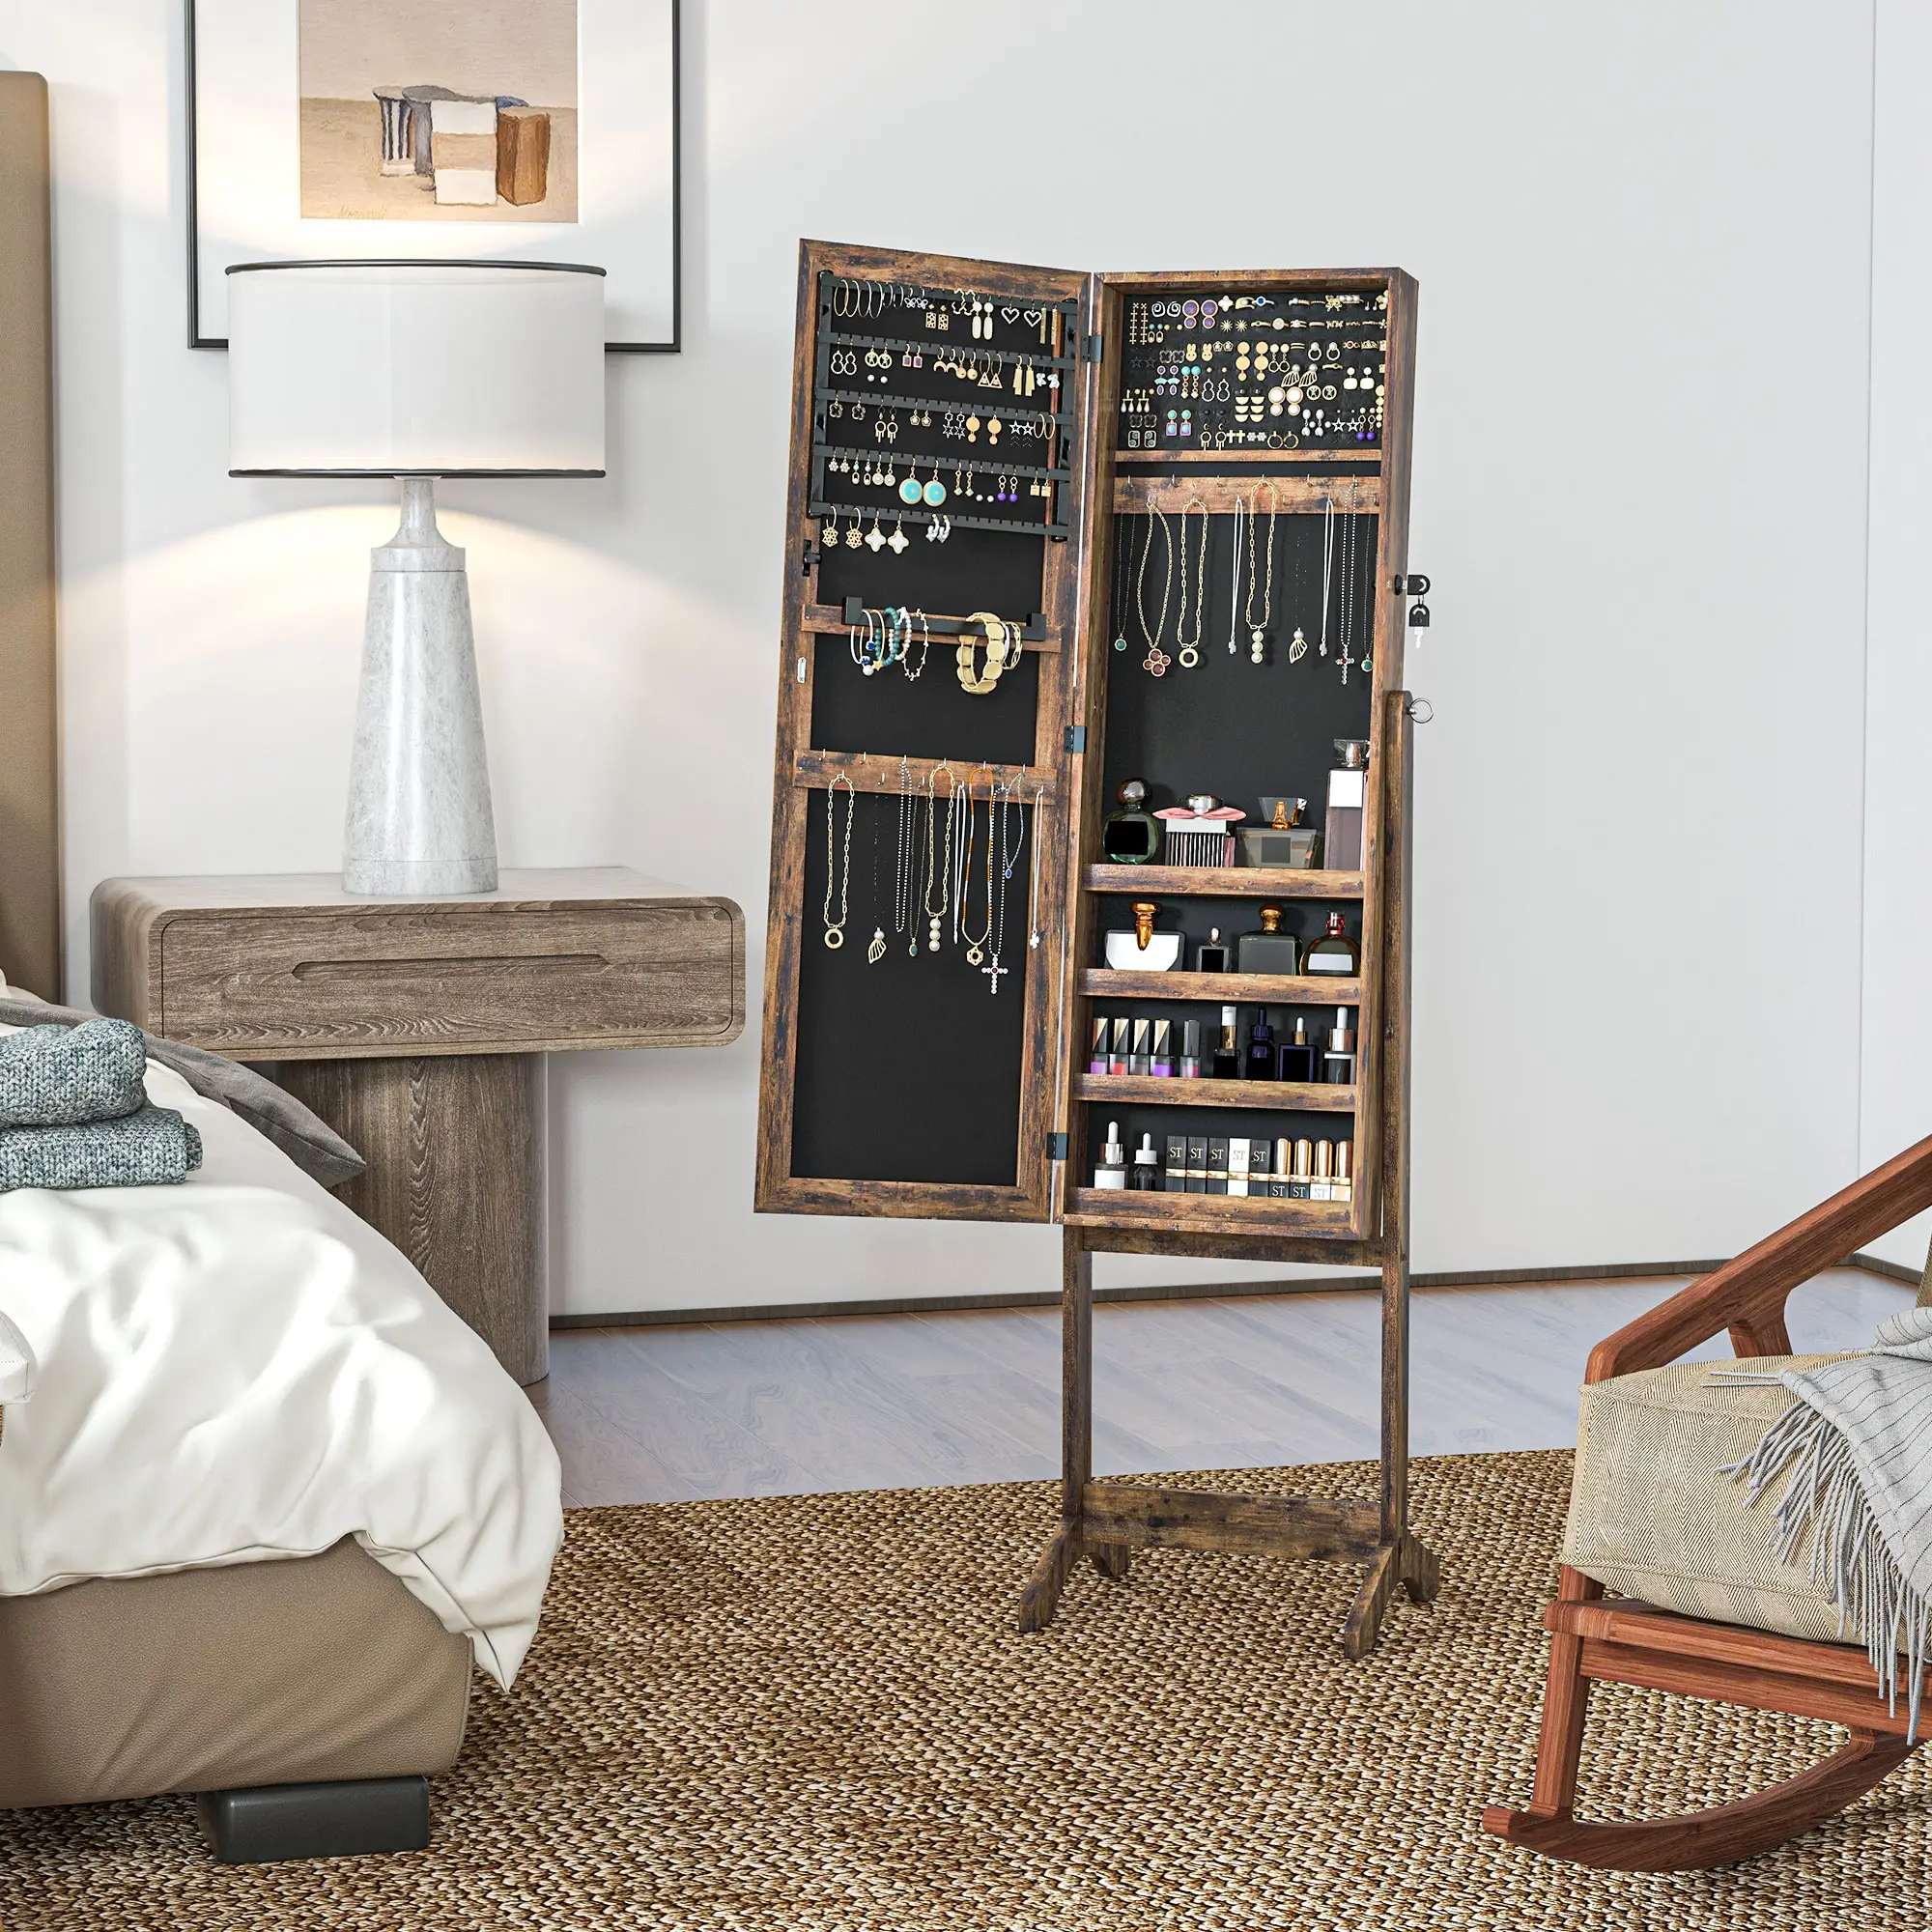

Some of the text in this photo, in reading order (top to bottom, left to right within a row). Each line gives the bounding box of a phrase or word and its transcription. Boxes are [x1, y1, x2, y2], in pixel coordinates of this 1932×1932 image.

[1170, 1147, 1182, 1158] ST
[1190, 1148, 1203, 1159] ST
[1211, 1149, 1224, 1160] ST
[1253, 1151, 1265, 1162] ST
[1272, 1185, 1285, 1197] ST
[1293, 1186, 1306, 1198] ST
